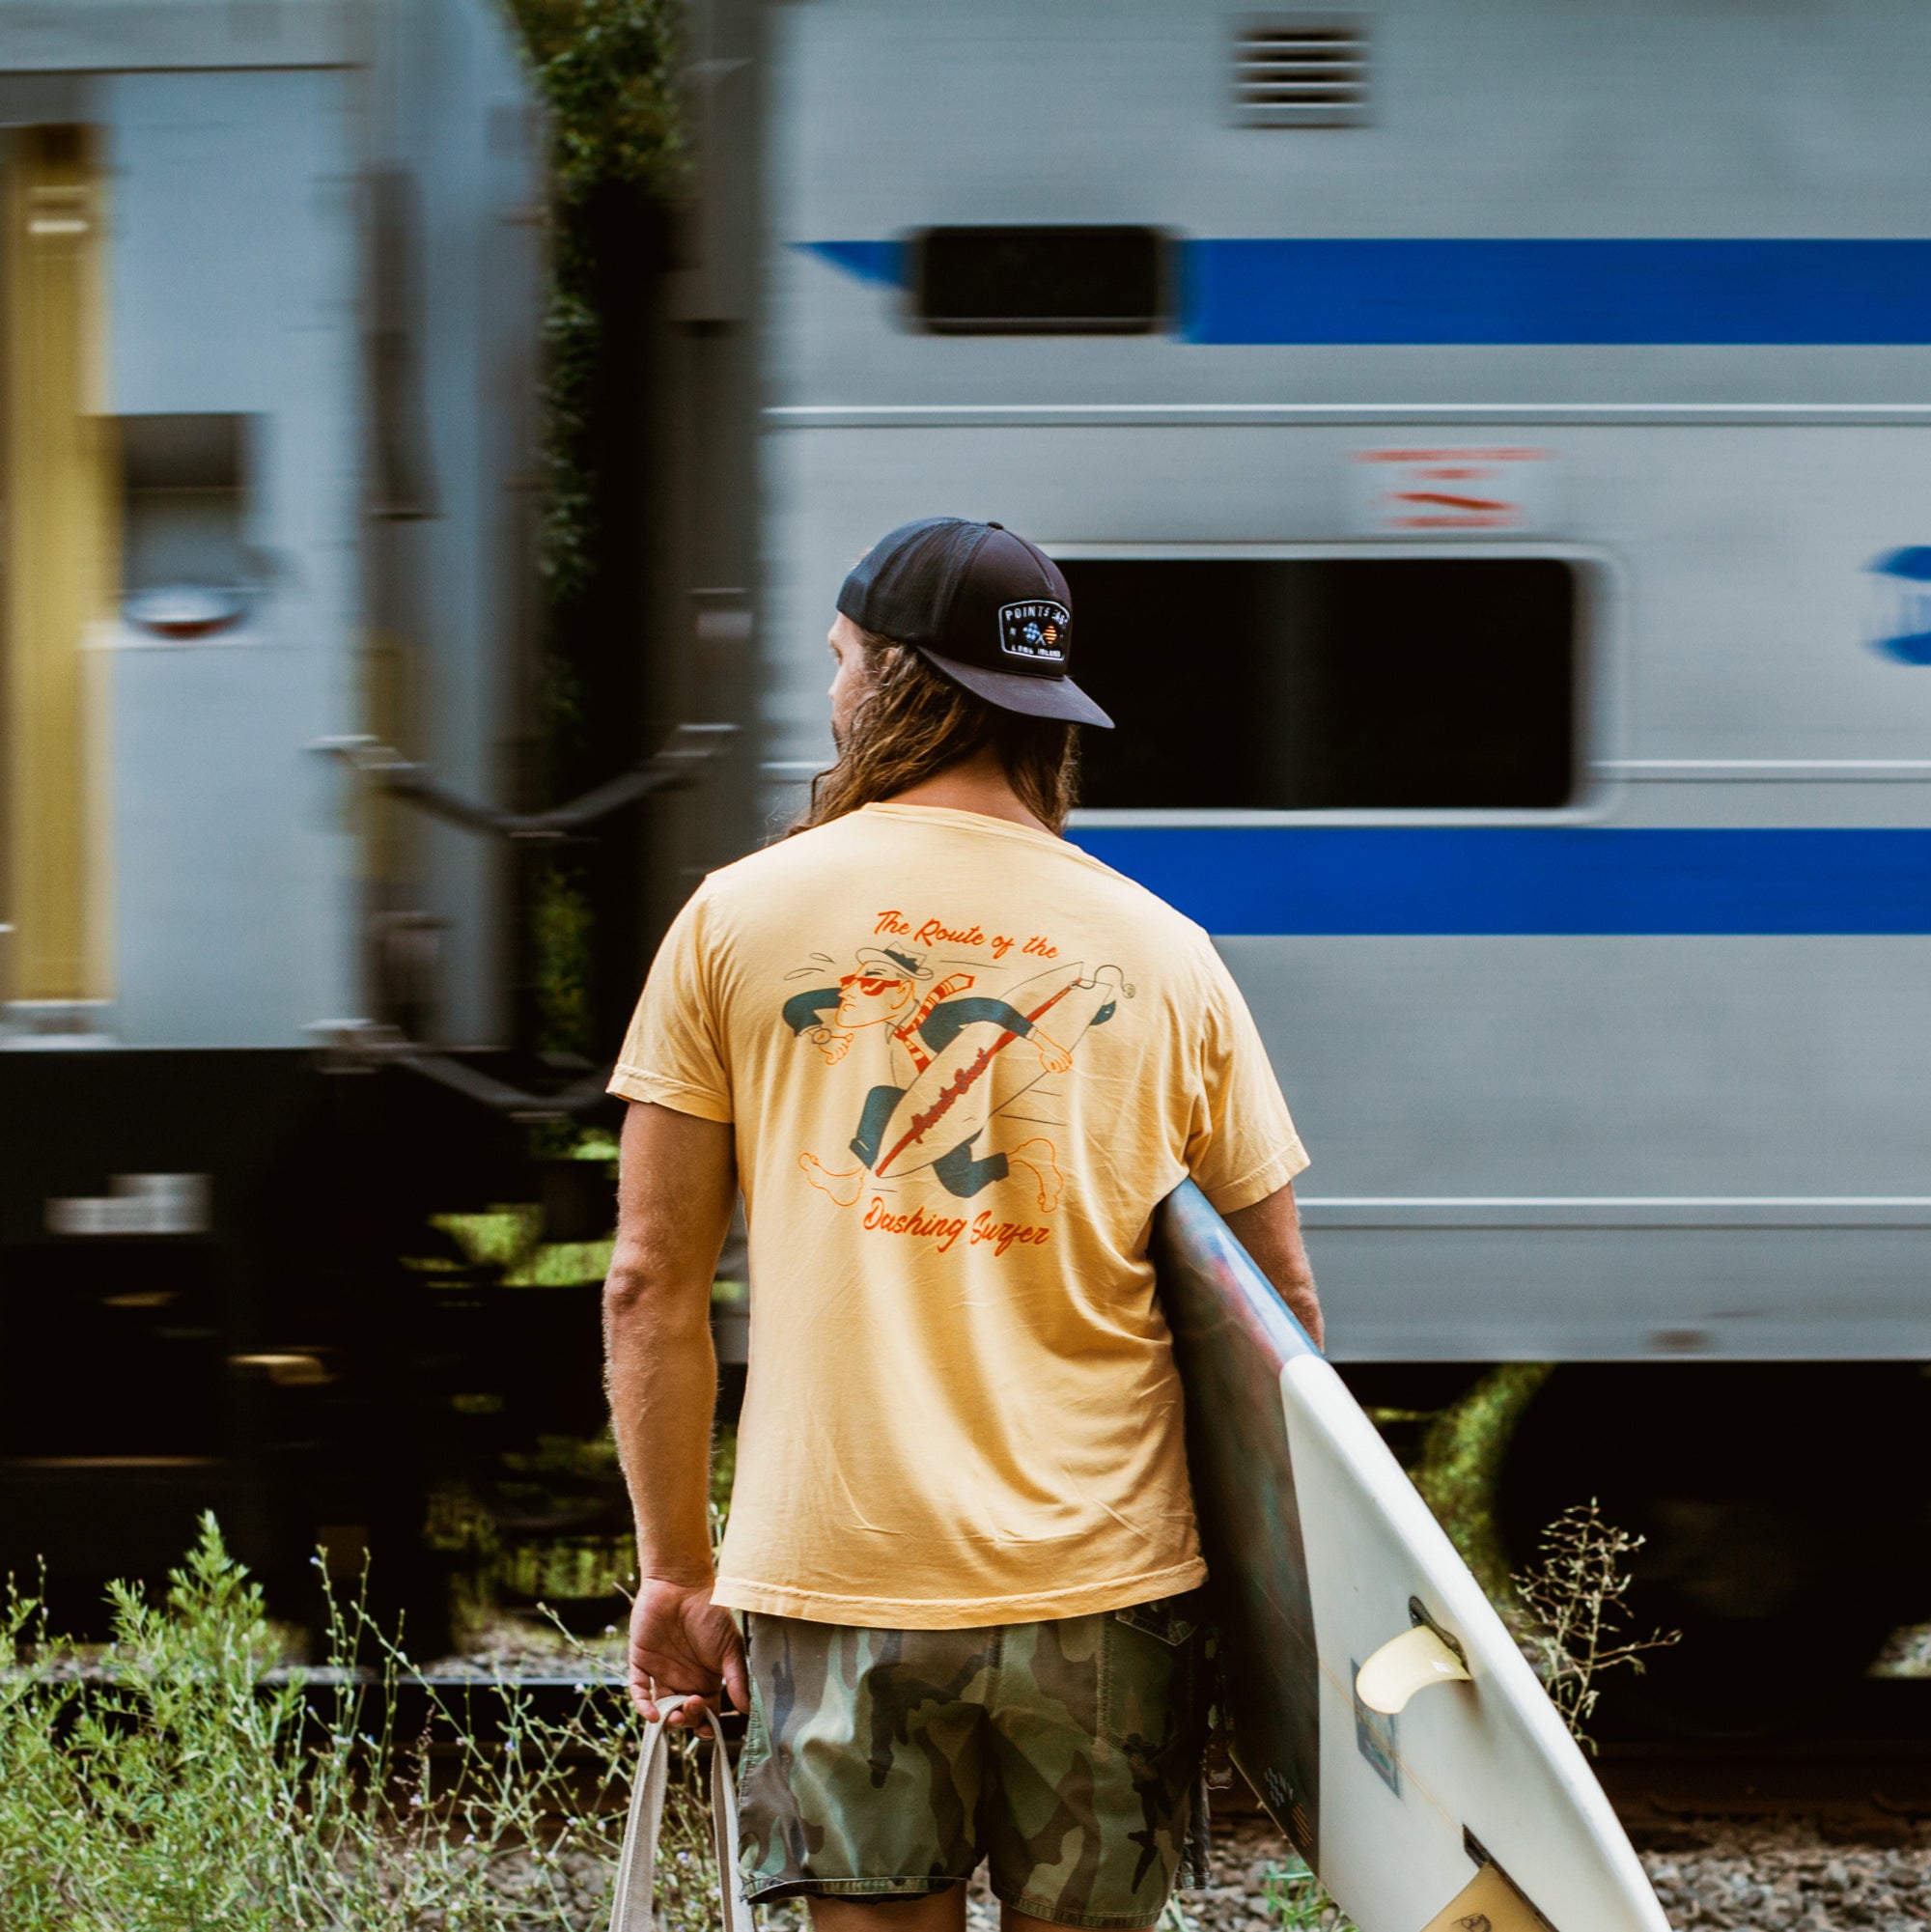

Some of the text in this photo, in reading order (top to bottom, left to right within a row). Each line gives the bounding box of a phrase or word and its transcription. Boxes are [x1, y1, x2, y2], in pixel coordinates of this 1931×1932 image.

[1005, 606, 1050, 621] POINTS
[874, 910, 1059, 960] The Route of the
[863, 1196, 1049, 1256] Dashing Surfer
